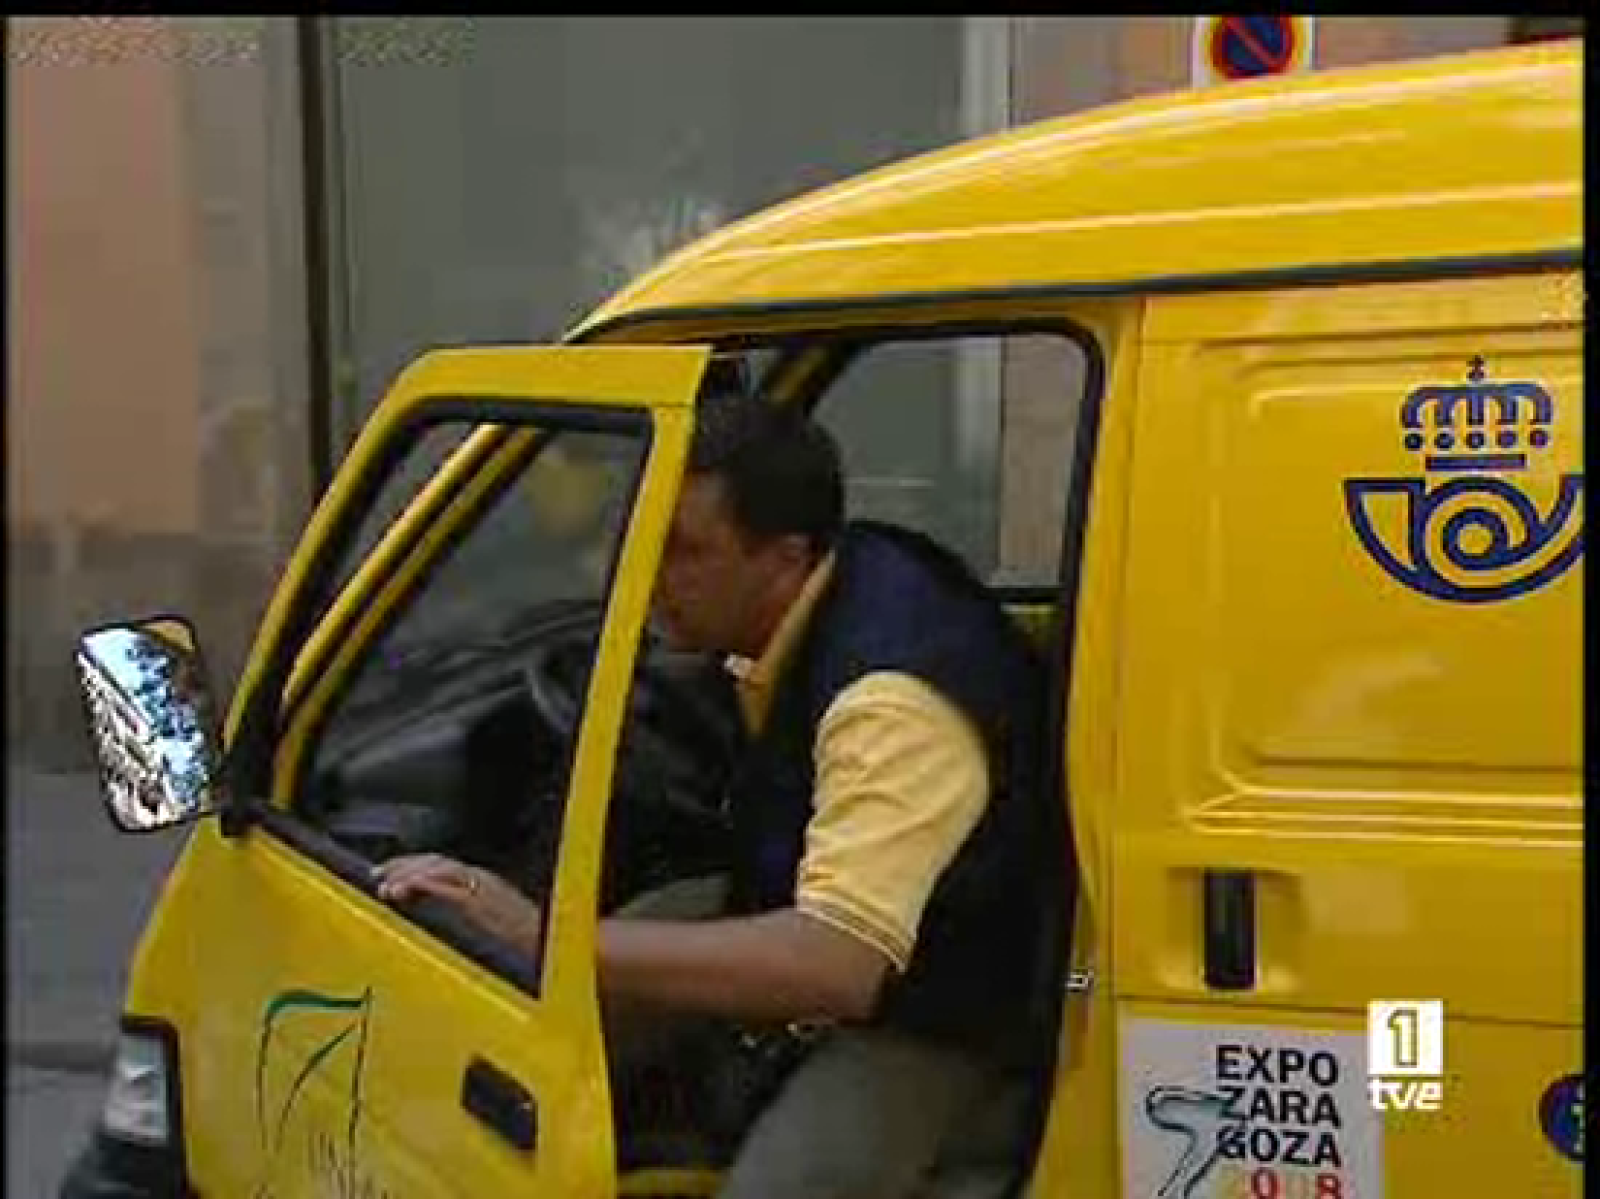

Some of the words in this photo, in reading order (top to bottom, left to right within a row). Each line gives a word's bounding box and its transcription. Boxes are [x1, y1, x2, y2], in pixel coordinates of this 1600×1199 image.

[1216, 1045, 1338, 1085] EXPO
[1217, 1086, 1341, 1128] ZARA
[1217, 1126, 1341, 1167] GOZA
